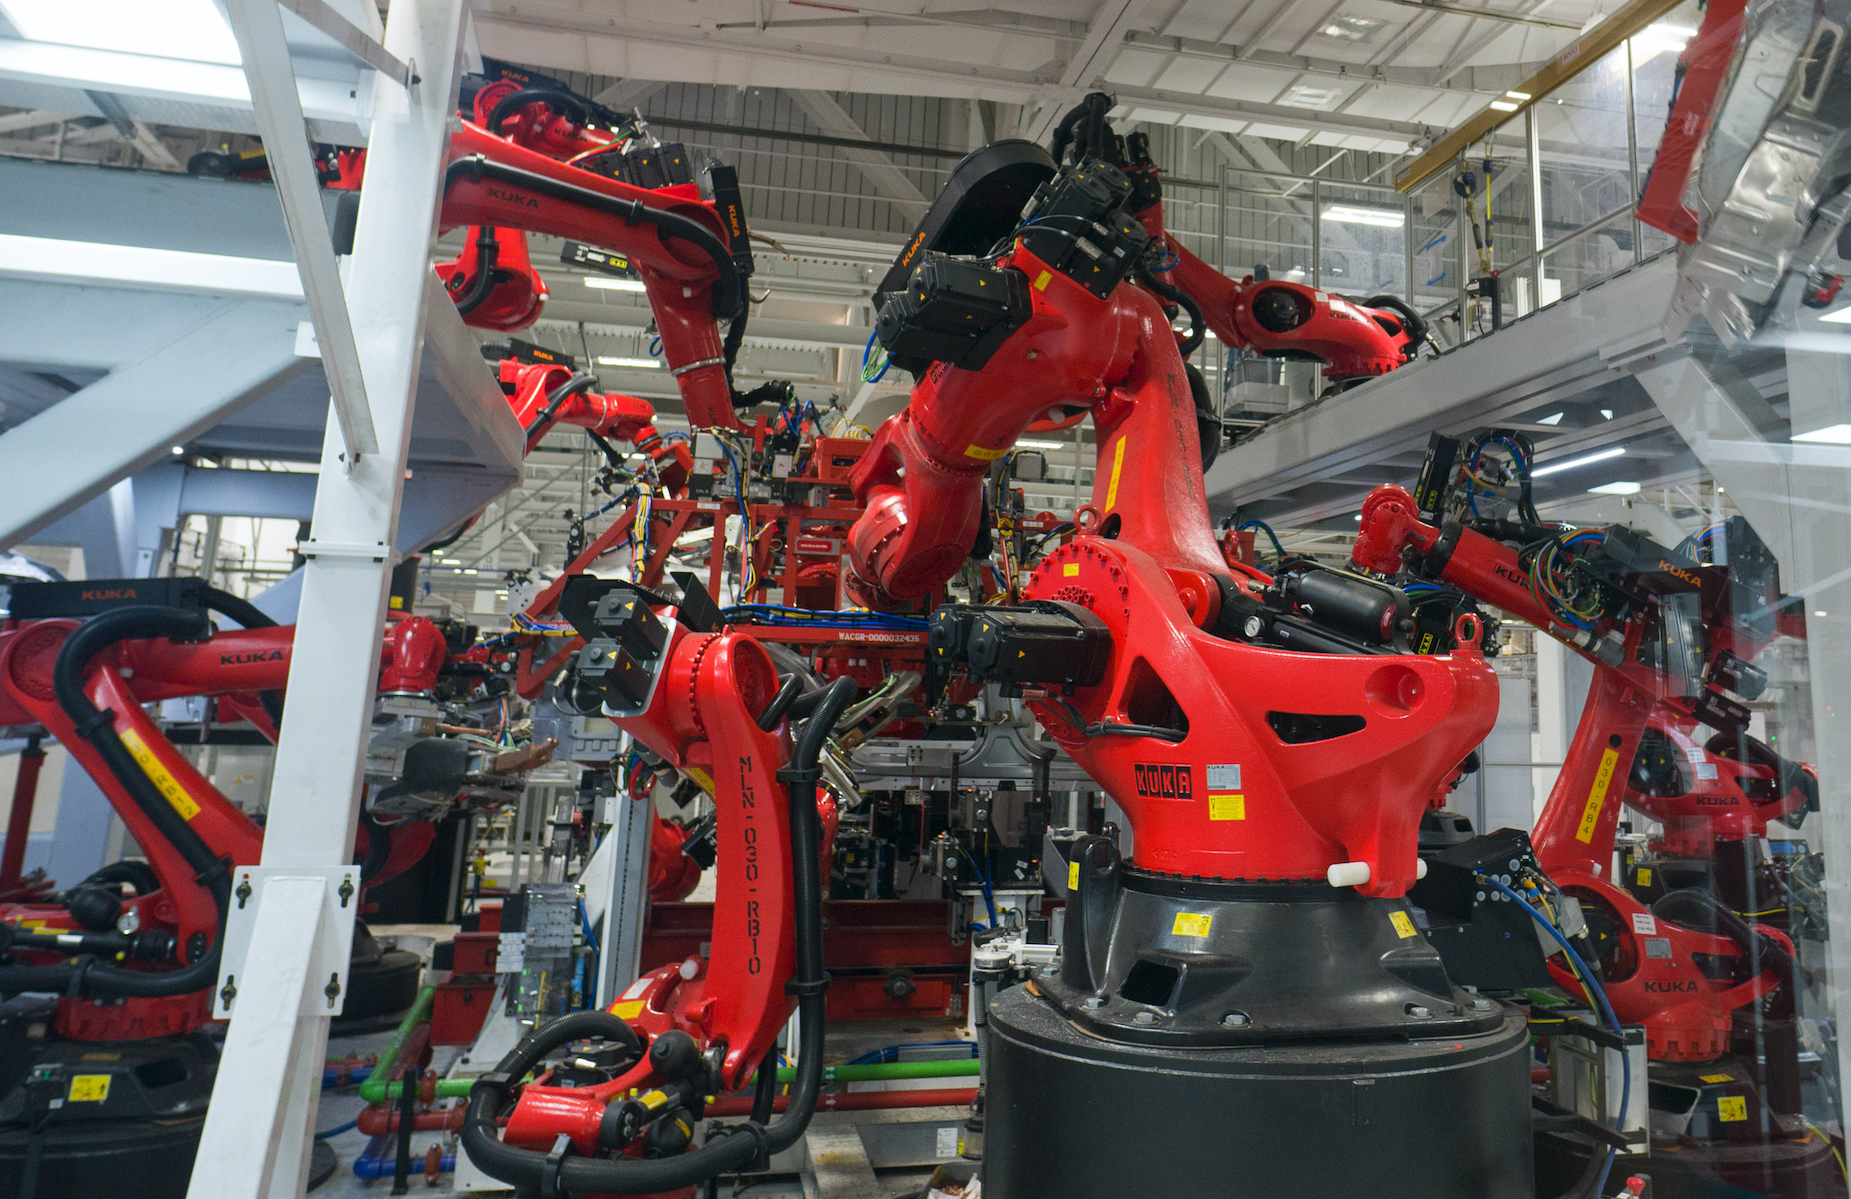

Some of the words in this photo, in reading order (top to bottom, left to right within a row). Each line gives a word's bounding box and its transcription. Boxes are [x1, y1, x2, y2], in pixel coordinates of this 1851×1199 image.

[489, 191, 539, 209] KUKA
[728, 205, 740, 238] KUKA
[902, 232, 926, 267] KUKA
[1495, 565, 1530, 590] KUK
[1658, 560, 1702, 588] KUKA
[82, 588, 138, 600] KUKA
[221, 650, 283, 665] KUKA
[1135, 768, 1192, 796] KUKA
[1582, 757, 1613, 835] 030-RB4
[1696, 796, 1740, 806] KUKA
[739, 756, 761, 975] MLN-030-RB10
[1645, 981, 1698, 992] KUKA
